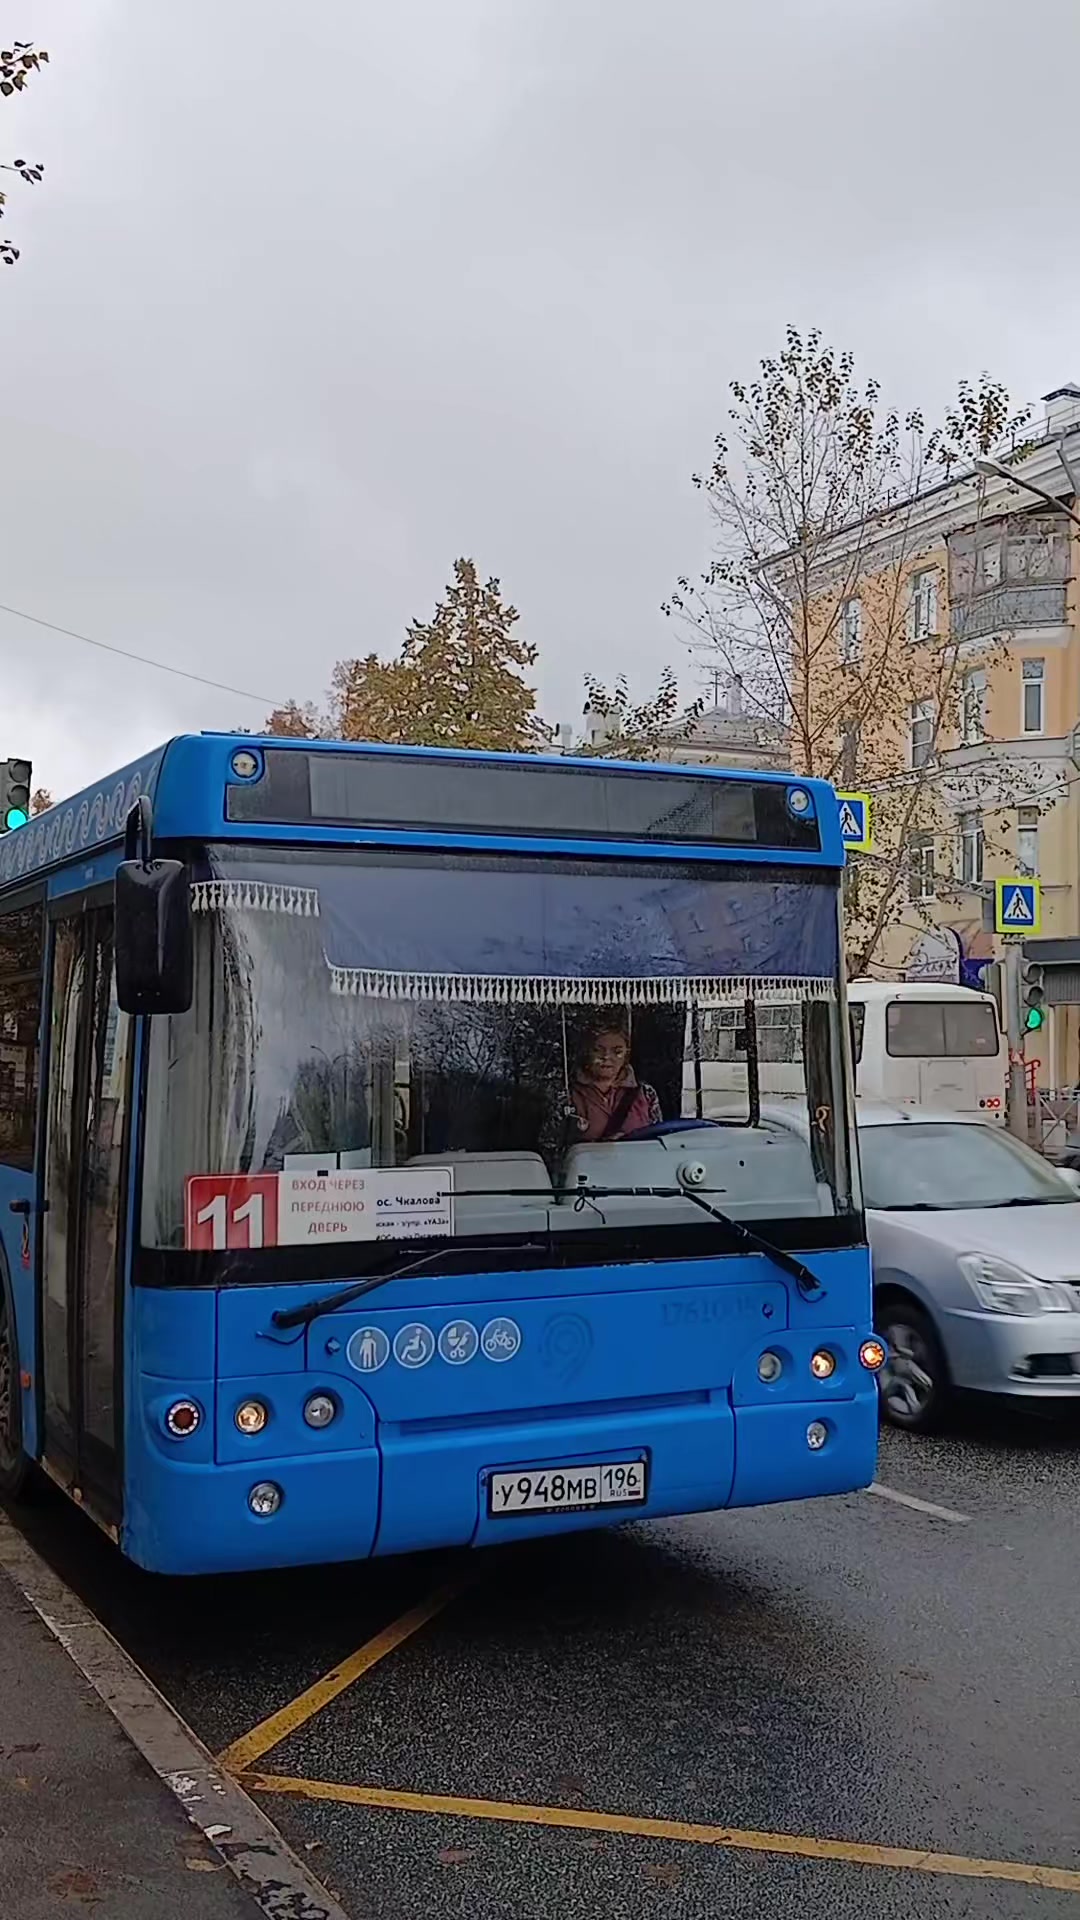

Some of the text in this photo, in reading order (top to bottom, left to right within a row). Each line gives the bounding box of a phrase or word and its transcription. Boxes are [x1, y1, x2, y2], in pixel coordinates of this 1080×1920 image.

[292, 1179, 365, 1192] ВХОД ЧЕРЕЗ
[291, 1201, 365, 1214] ПЕРЕДНЮЮ
[376, 1195, 441, 1207] ос. Чкалова
[197, 1193, 263, 1250] 11
[308, 1222, 348, 1235] ДВЕРЬ
[500, 1466, 637, 1506] У948МВ 196
[610, 1488, 628, 1497] RUS
